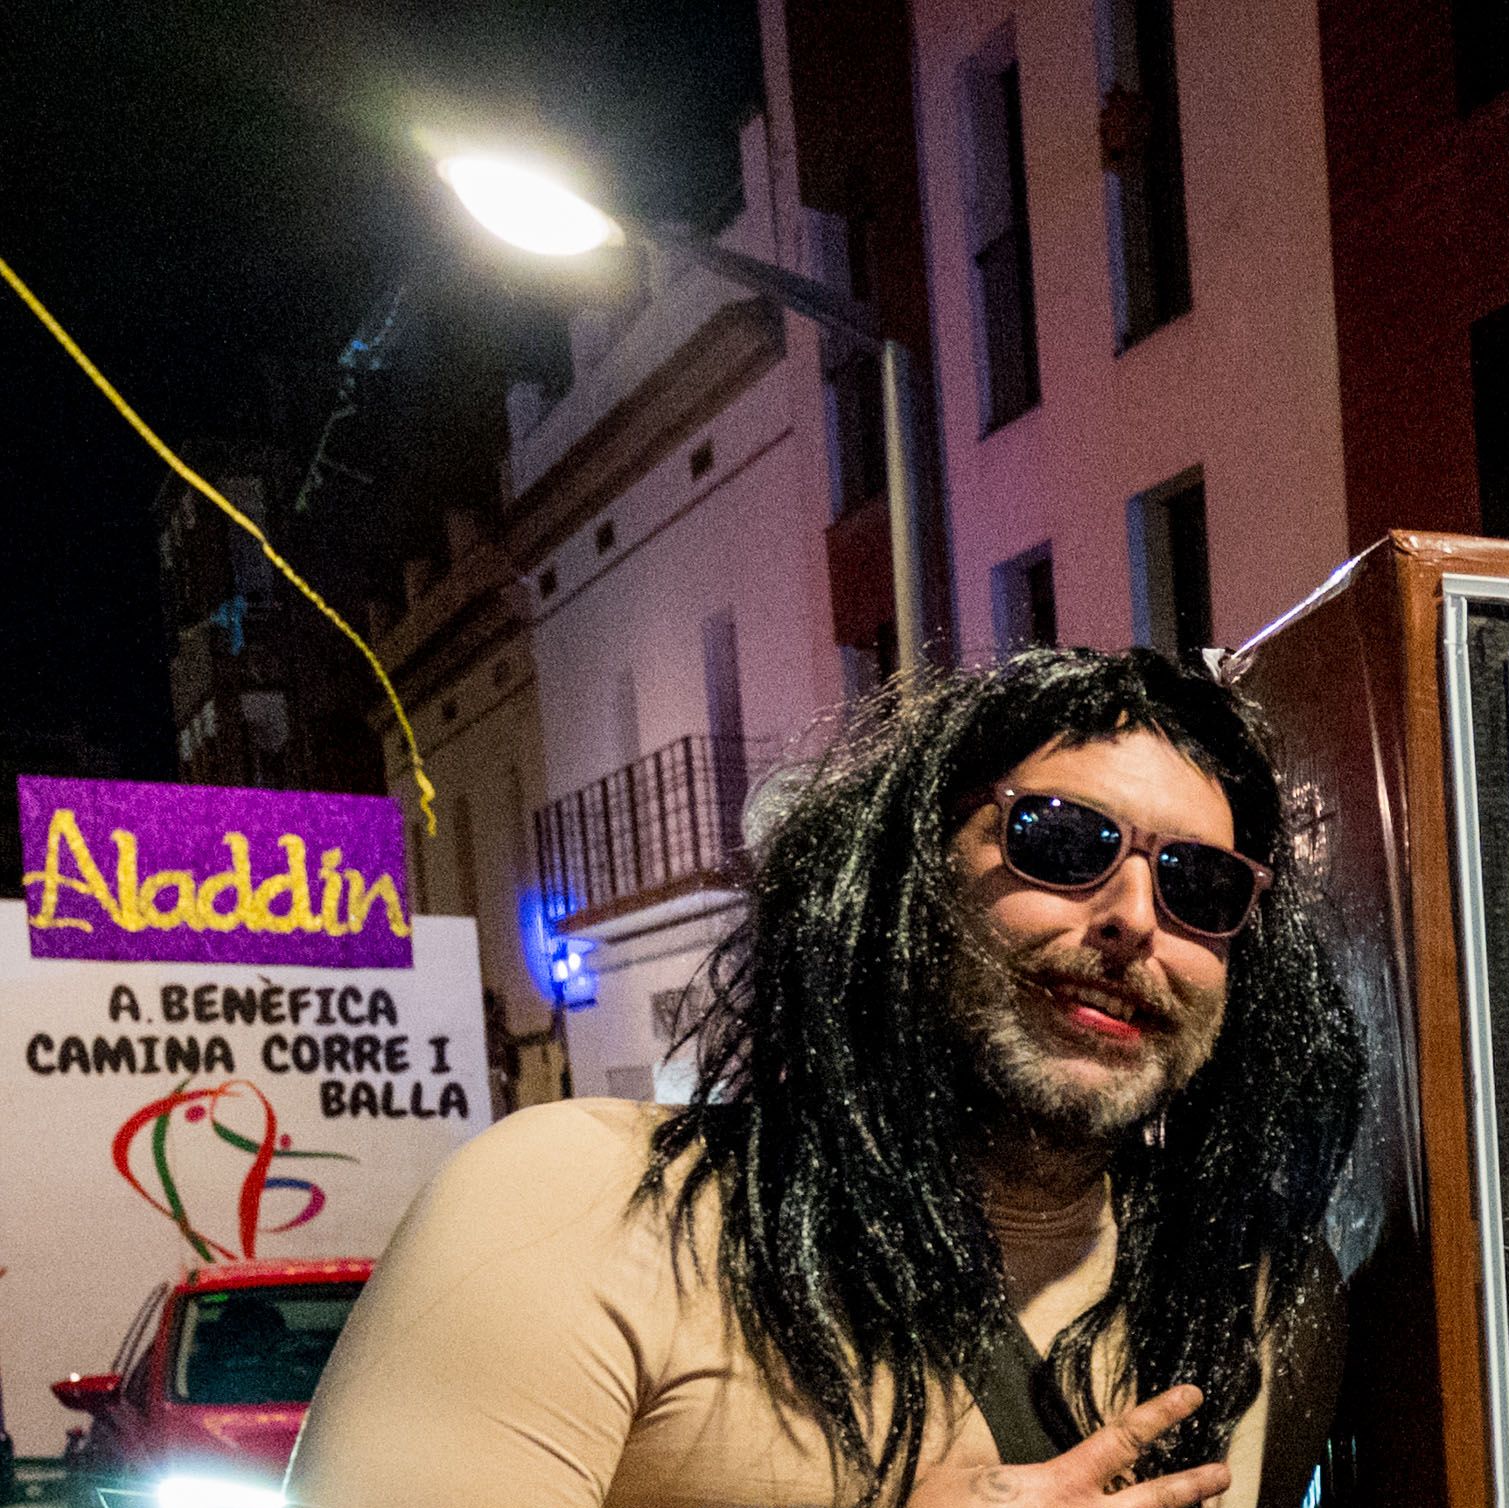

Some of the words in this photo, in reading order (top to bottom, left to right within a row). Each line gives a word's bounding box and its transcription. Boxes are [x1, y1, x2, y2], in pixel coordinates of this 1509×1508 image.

[23, 808, 414, 938] Aladdin
[25, 1032, 236, 1074] CAMINA
[261, 1032, 409, 1074] CORRE
[428, 1036, 451, 1074] I
[319, 1080, 470, 1119] BALLA
